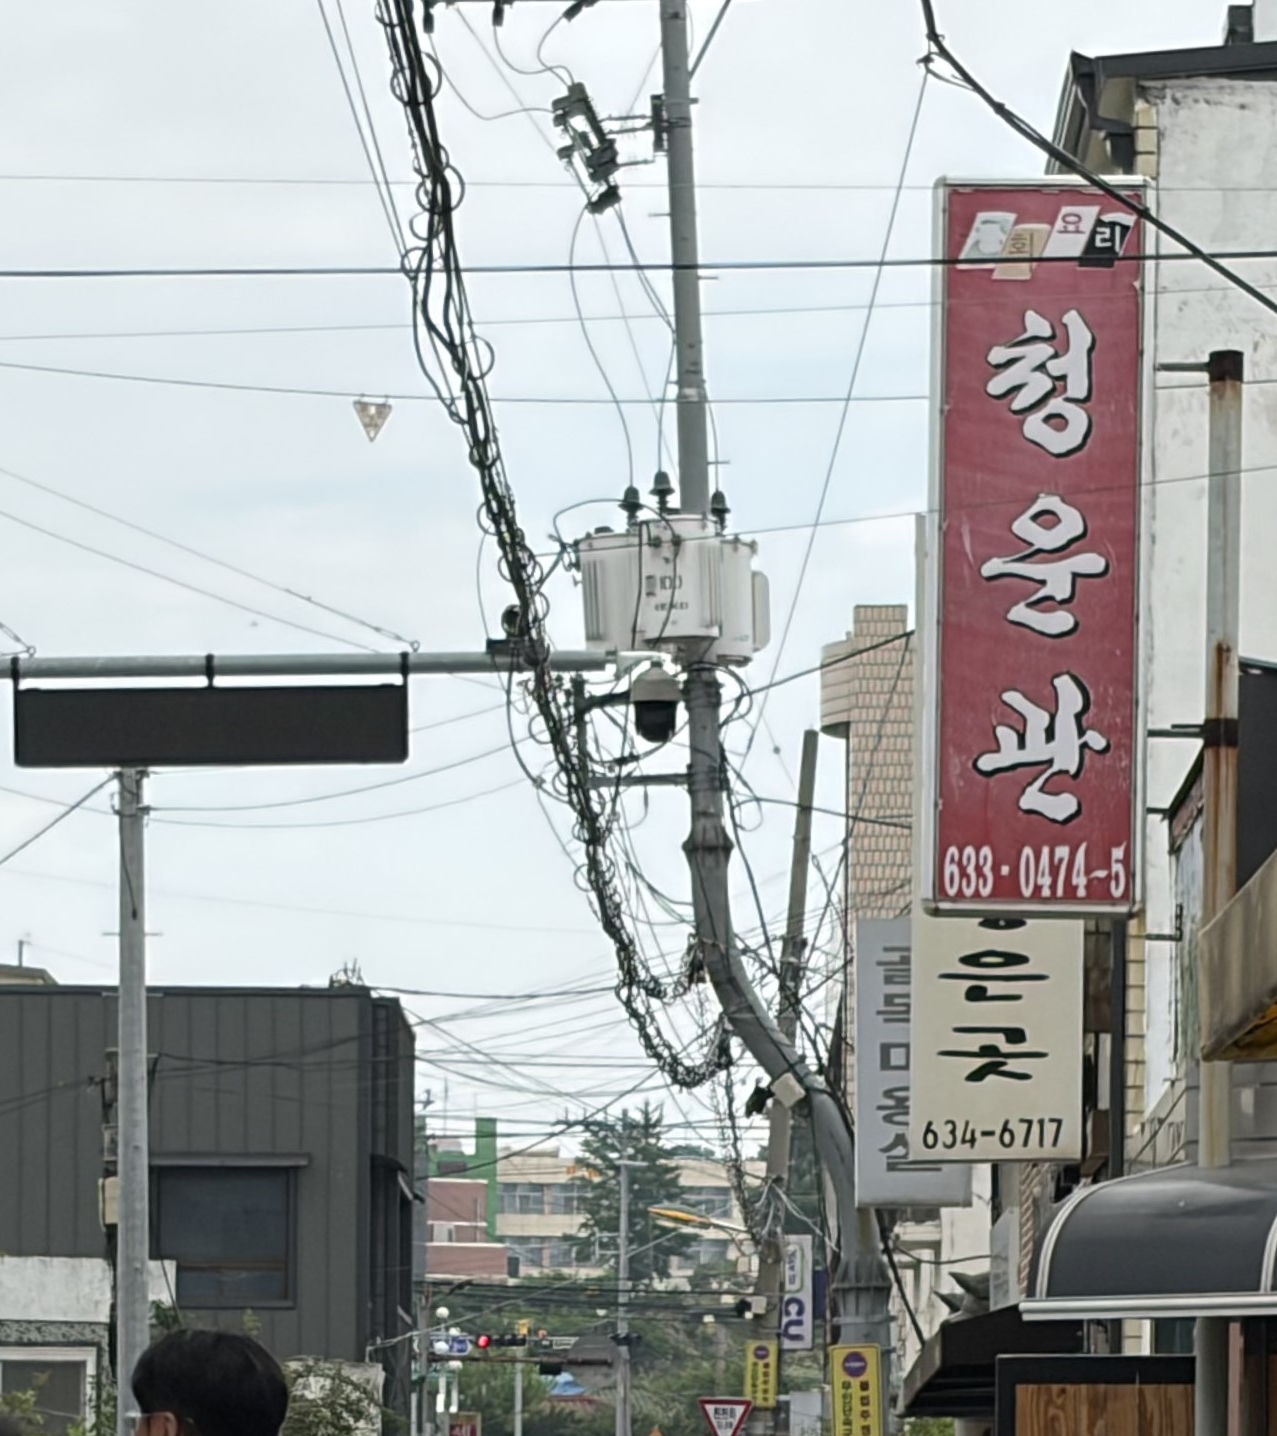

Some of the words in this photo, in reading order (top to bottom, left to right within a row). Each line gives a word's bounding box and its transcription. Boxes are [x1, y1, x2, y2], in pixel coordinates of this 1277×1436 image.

[973, 307, 1111, 826] 청운관
[922, 1118, 1063, 1150] 634-6717
[782, 1296, 805, 1341] CU
